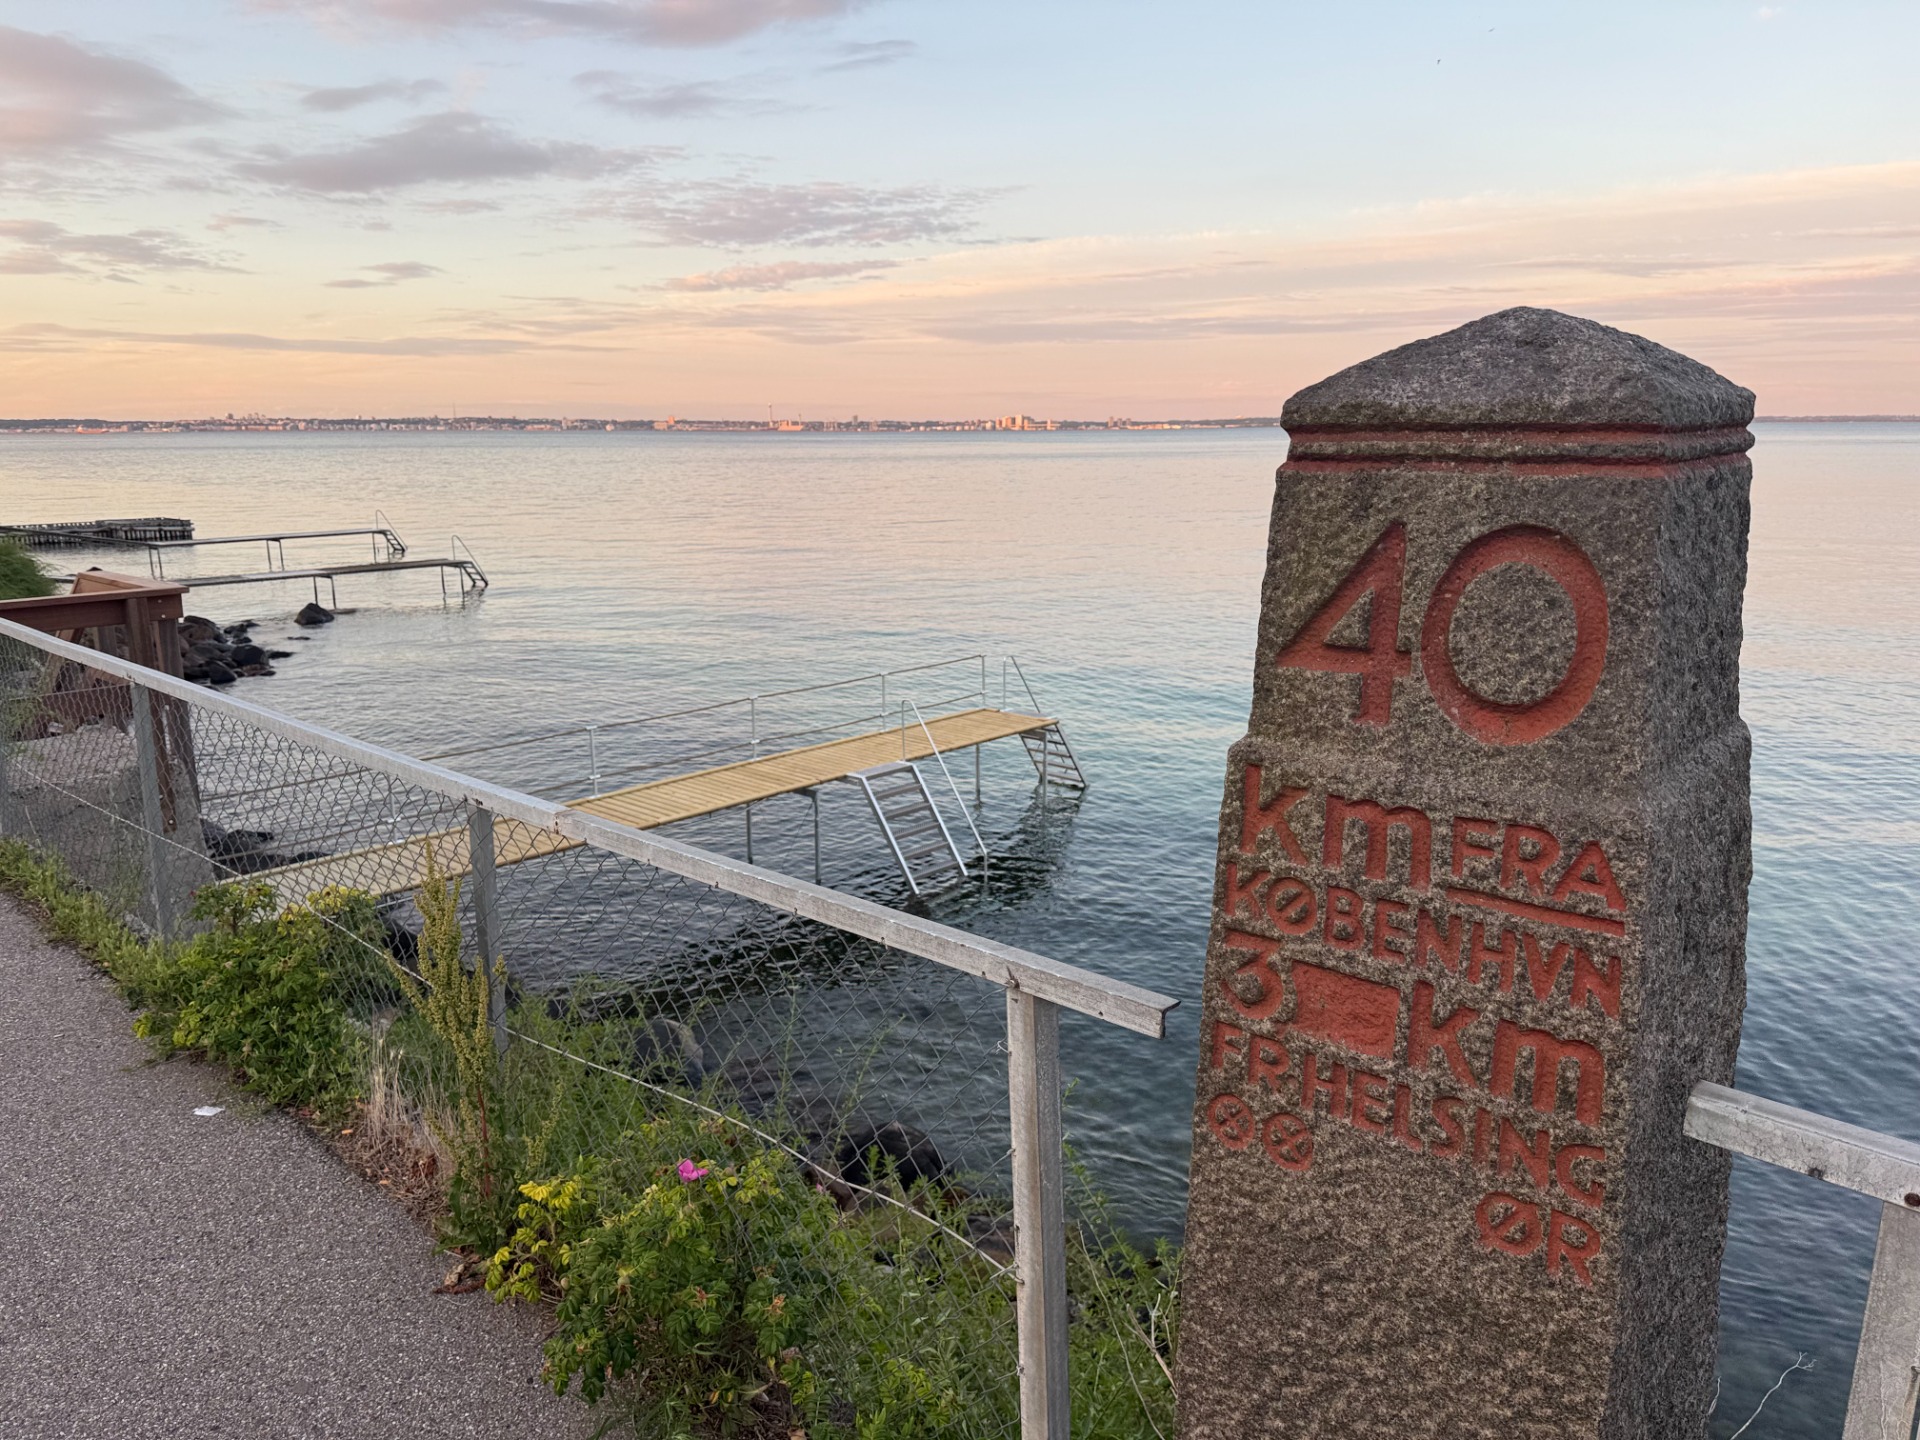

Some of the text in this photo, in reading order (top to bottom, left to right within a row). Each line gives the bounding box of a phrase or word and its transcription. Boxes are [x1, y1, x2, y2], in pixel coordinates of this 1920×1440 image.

[1275, 519, 1609, 746] 40
[1452, 815, 1627, 912] FRA
[1220, 927, 1284, 1021] 3
